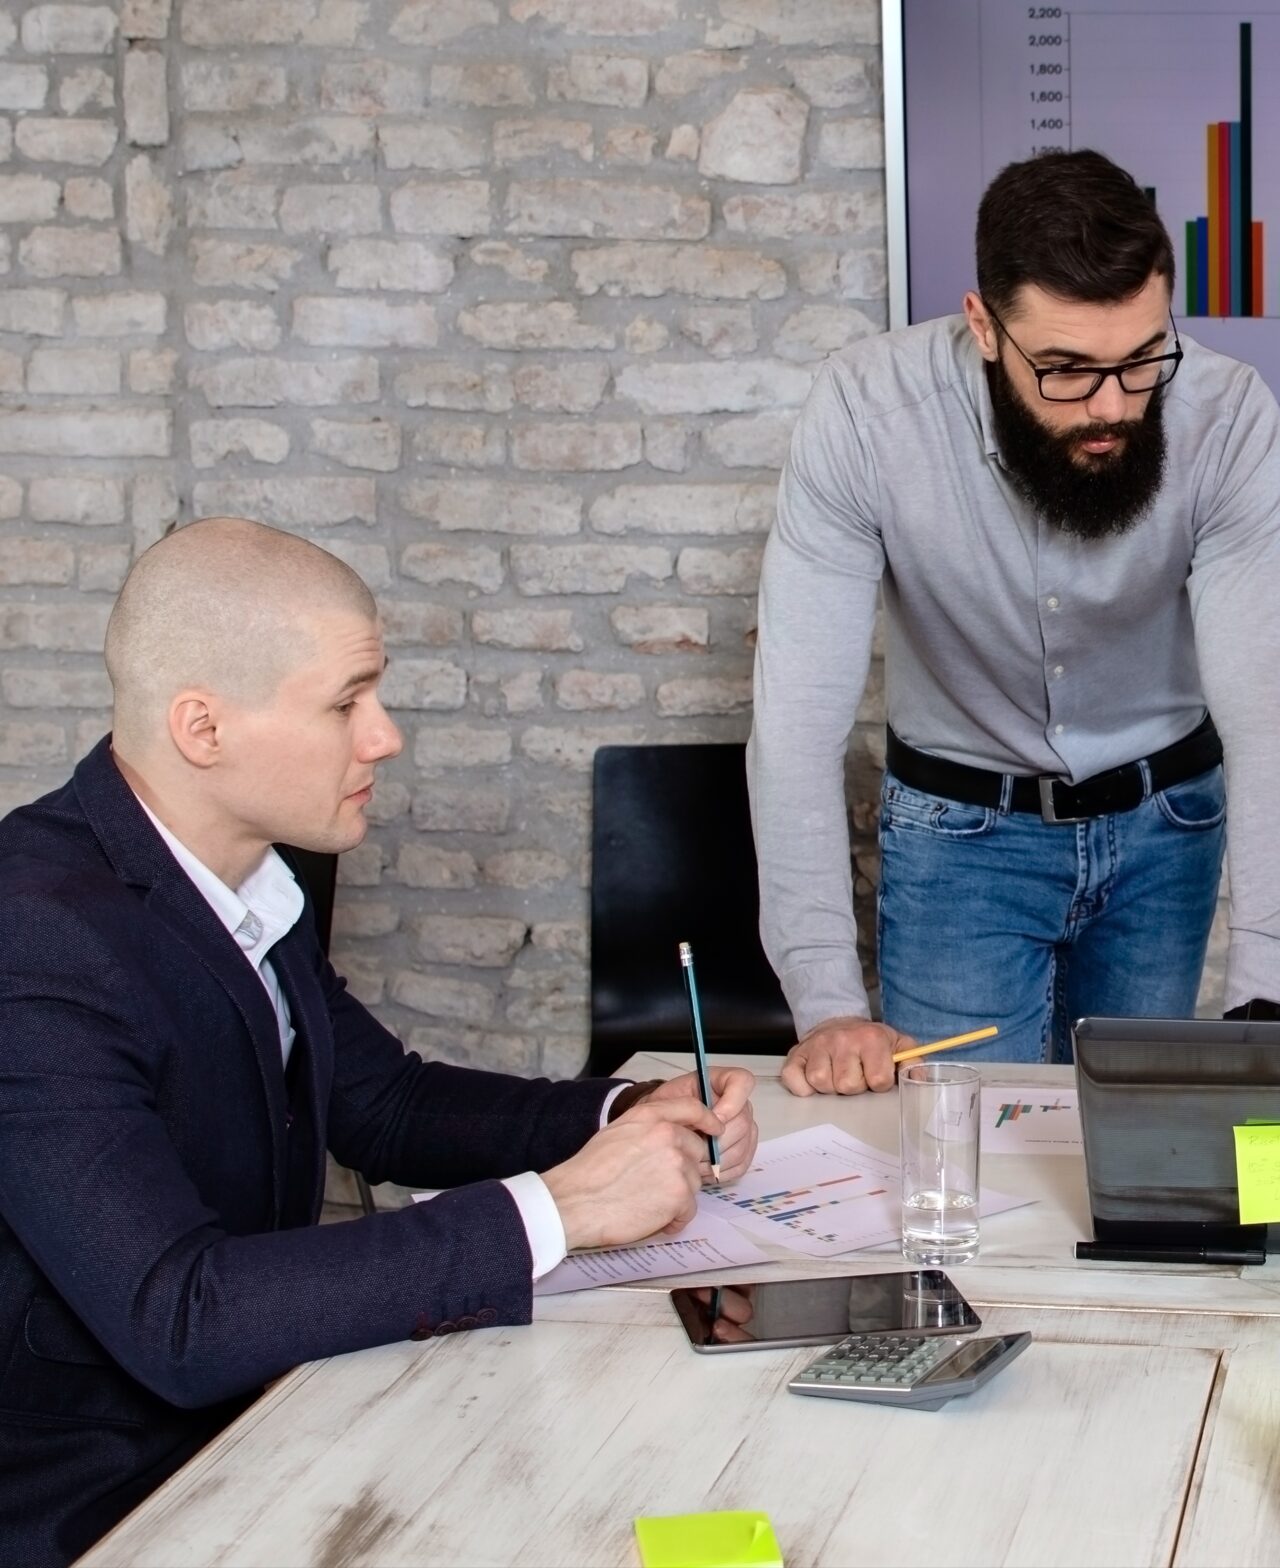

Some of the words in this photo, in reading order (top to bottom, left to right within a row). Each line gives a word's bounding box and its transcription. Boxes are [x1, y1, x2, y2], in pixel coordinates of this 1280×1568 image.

[1028, 8, 1062, 19] 2,200
[1028, 35, 1062, 47] 2,000
[1029, 64, 1063, 76] 1,800
[1030, 92, 1063, 103] 1,600
[1030, 119, 1064, 130] 1,400
